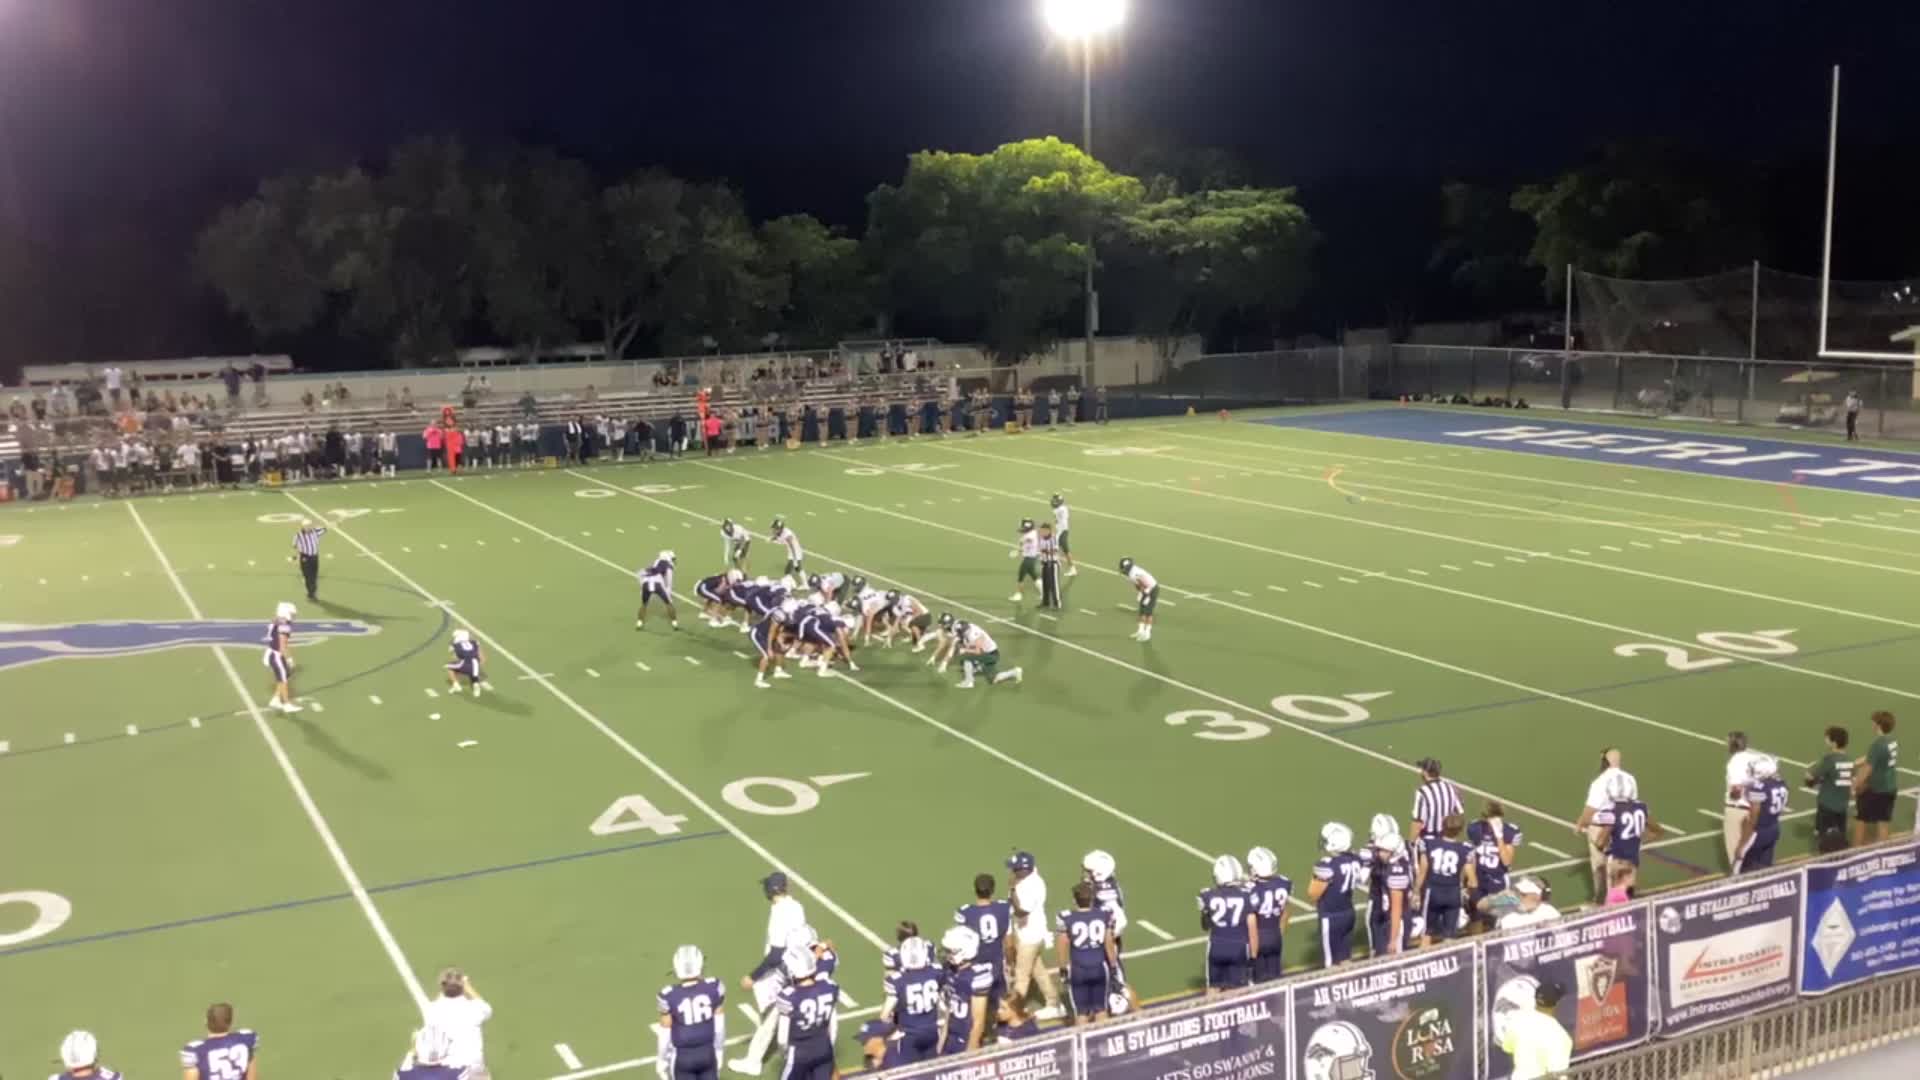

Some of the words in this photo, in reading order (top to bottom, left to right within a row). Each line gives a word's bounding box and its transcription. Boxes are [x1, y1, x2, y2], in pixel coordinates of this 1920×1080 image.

[1613, 631, 1798, 671] 20
[1165, 693, 1370, 741] 30
[589, 776, 820, 835] 40
[1620, 809, 1645, 840] 20
[1430, 848, 1459, 876] 18
[1209, 896, 1245, 928] 27
[1752, 880, 1798, 904] FOOTBALL
[1520, 930, 1580, 958] STALLIONS
[1582, 915, 1637, 943] FOOTBALL
[1313, 987, 1330, 1006] AH
[1332, 971, 1398, 1001] STALLIONS
[1401, 956, 1461, 986] FOOTBALL
[1107, 1035, 1126, 1056] AH
[1127, 1017, 1201, 1051] STALLIONS
[1204, 1002, 1271, 1033] FOOTBALL
[1000, 1049, 1057, 1075] HERITAGE
